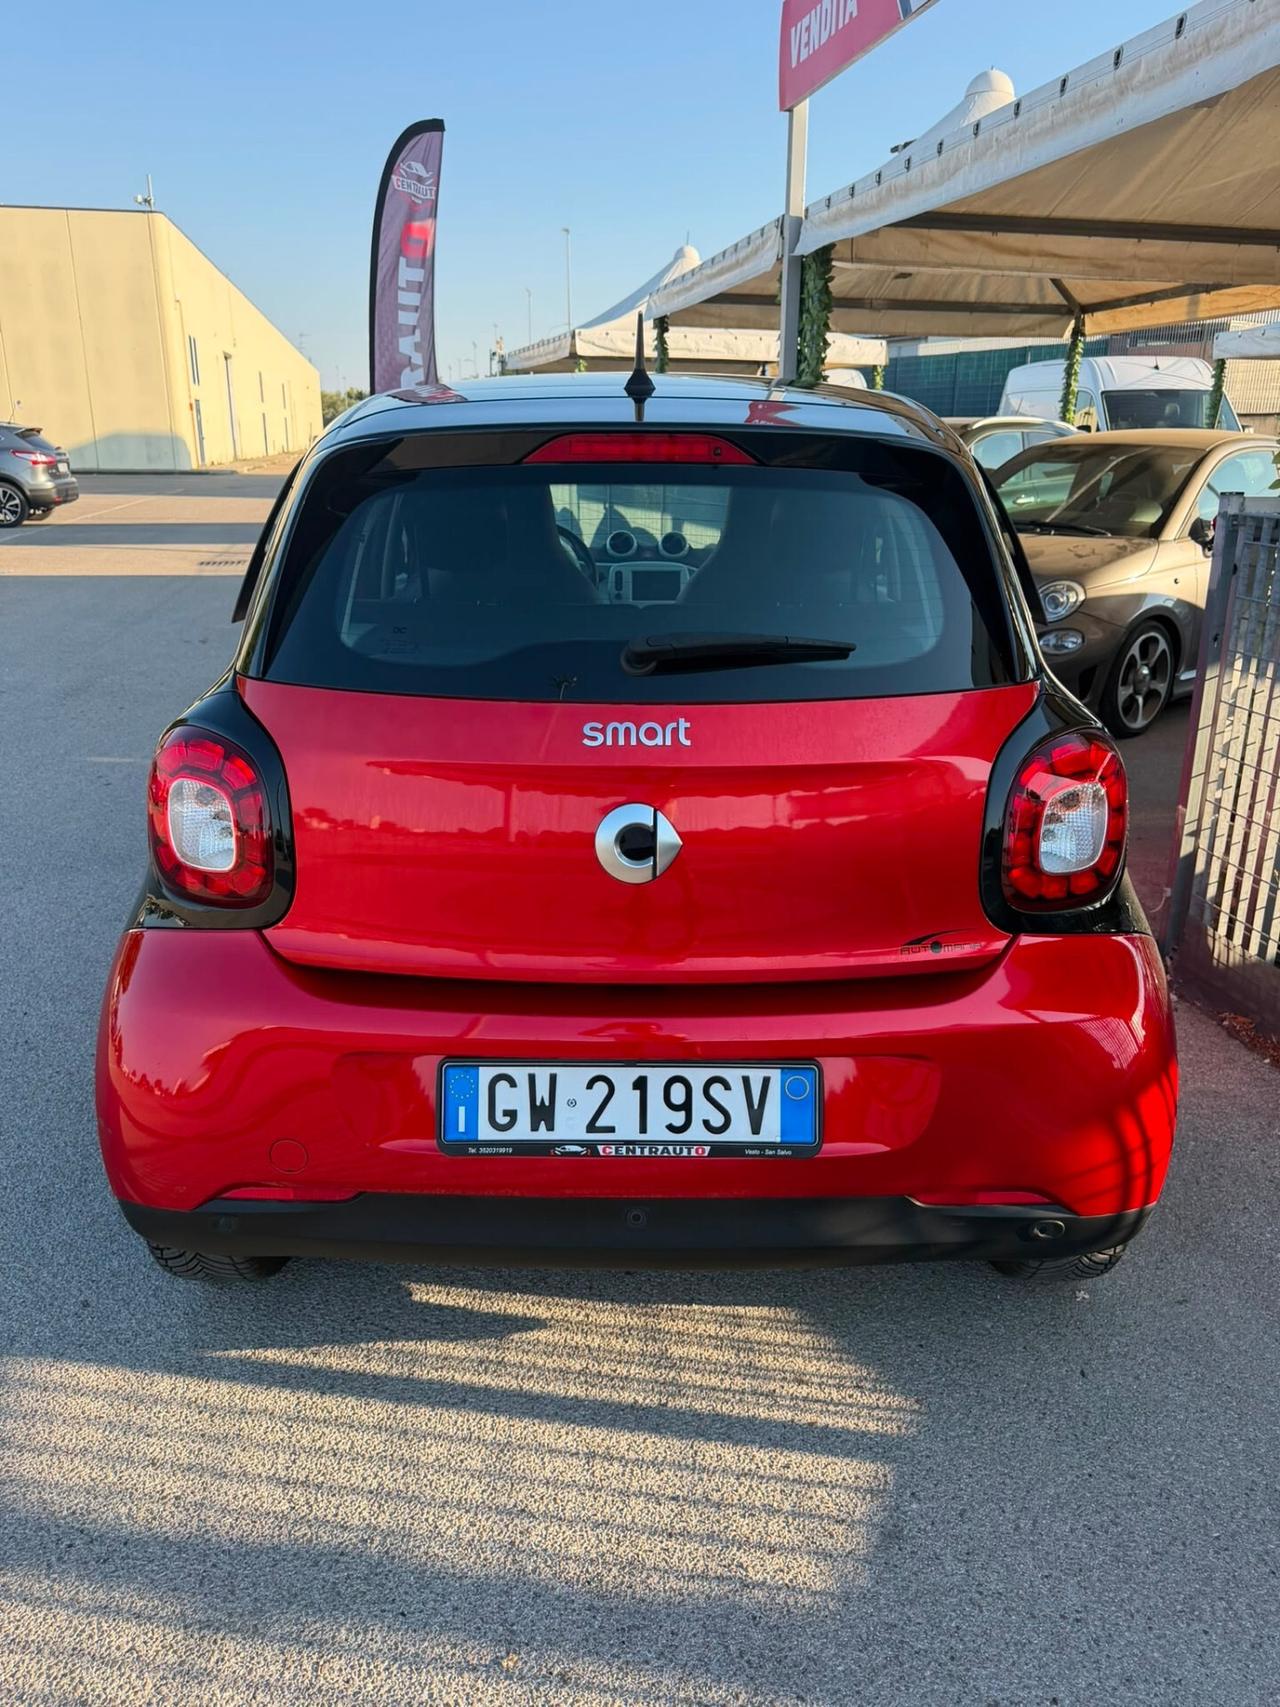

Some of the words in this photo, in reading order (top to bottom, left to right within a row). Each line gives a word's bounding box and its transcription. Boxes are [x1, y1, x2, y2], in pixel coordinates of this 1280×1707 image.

[582, 717, 691, 747] smart
[487, 1072, 558, 1133] GW
[584, 1074, 772, 1136] 219SV
[601, 1145, 706, 1156] CENTRAUTO
